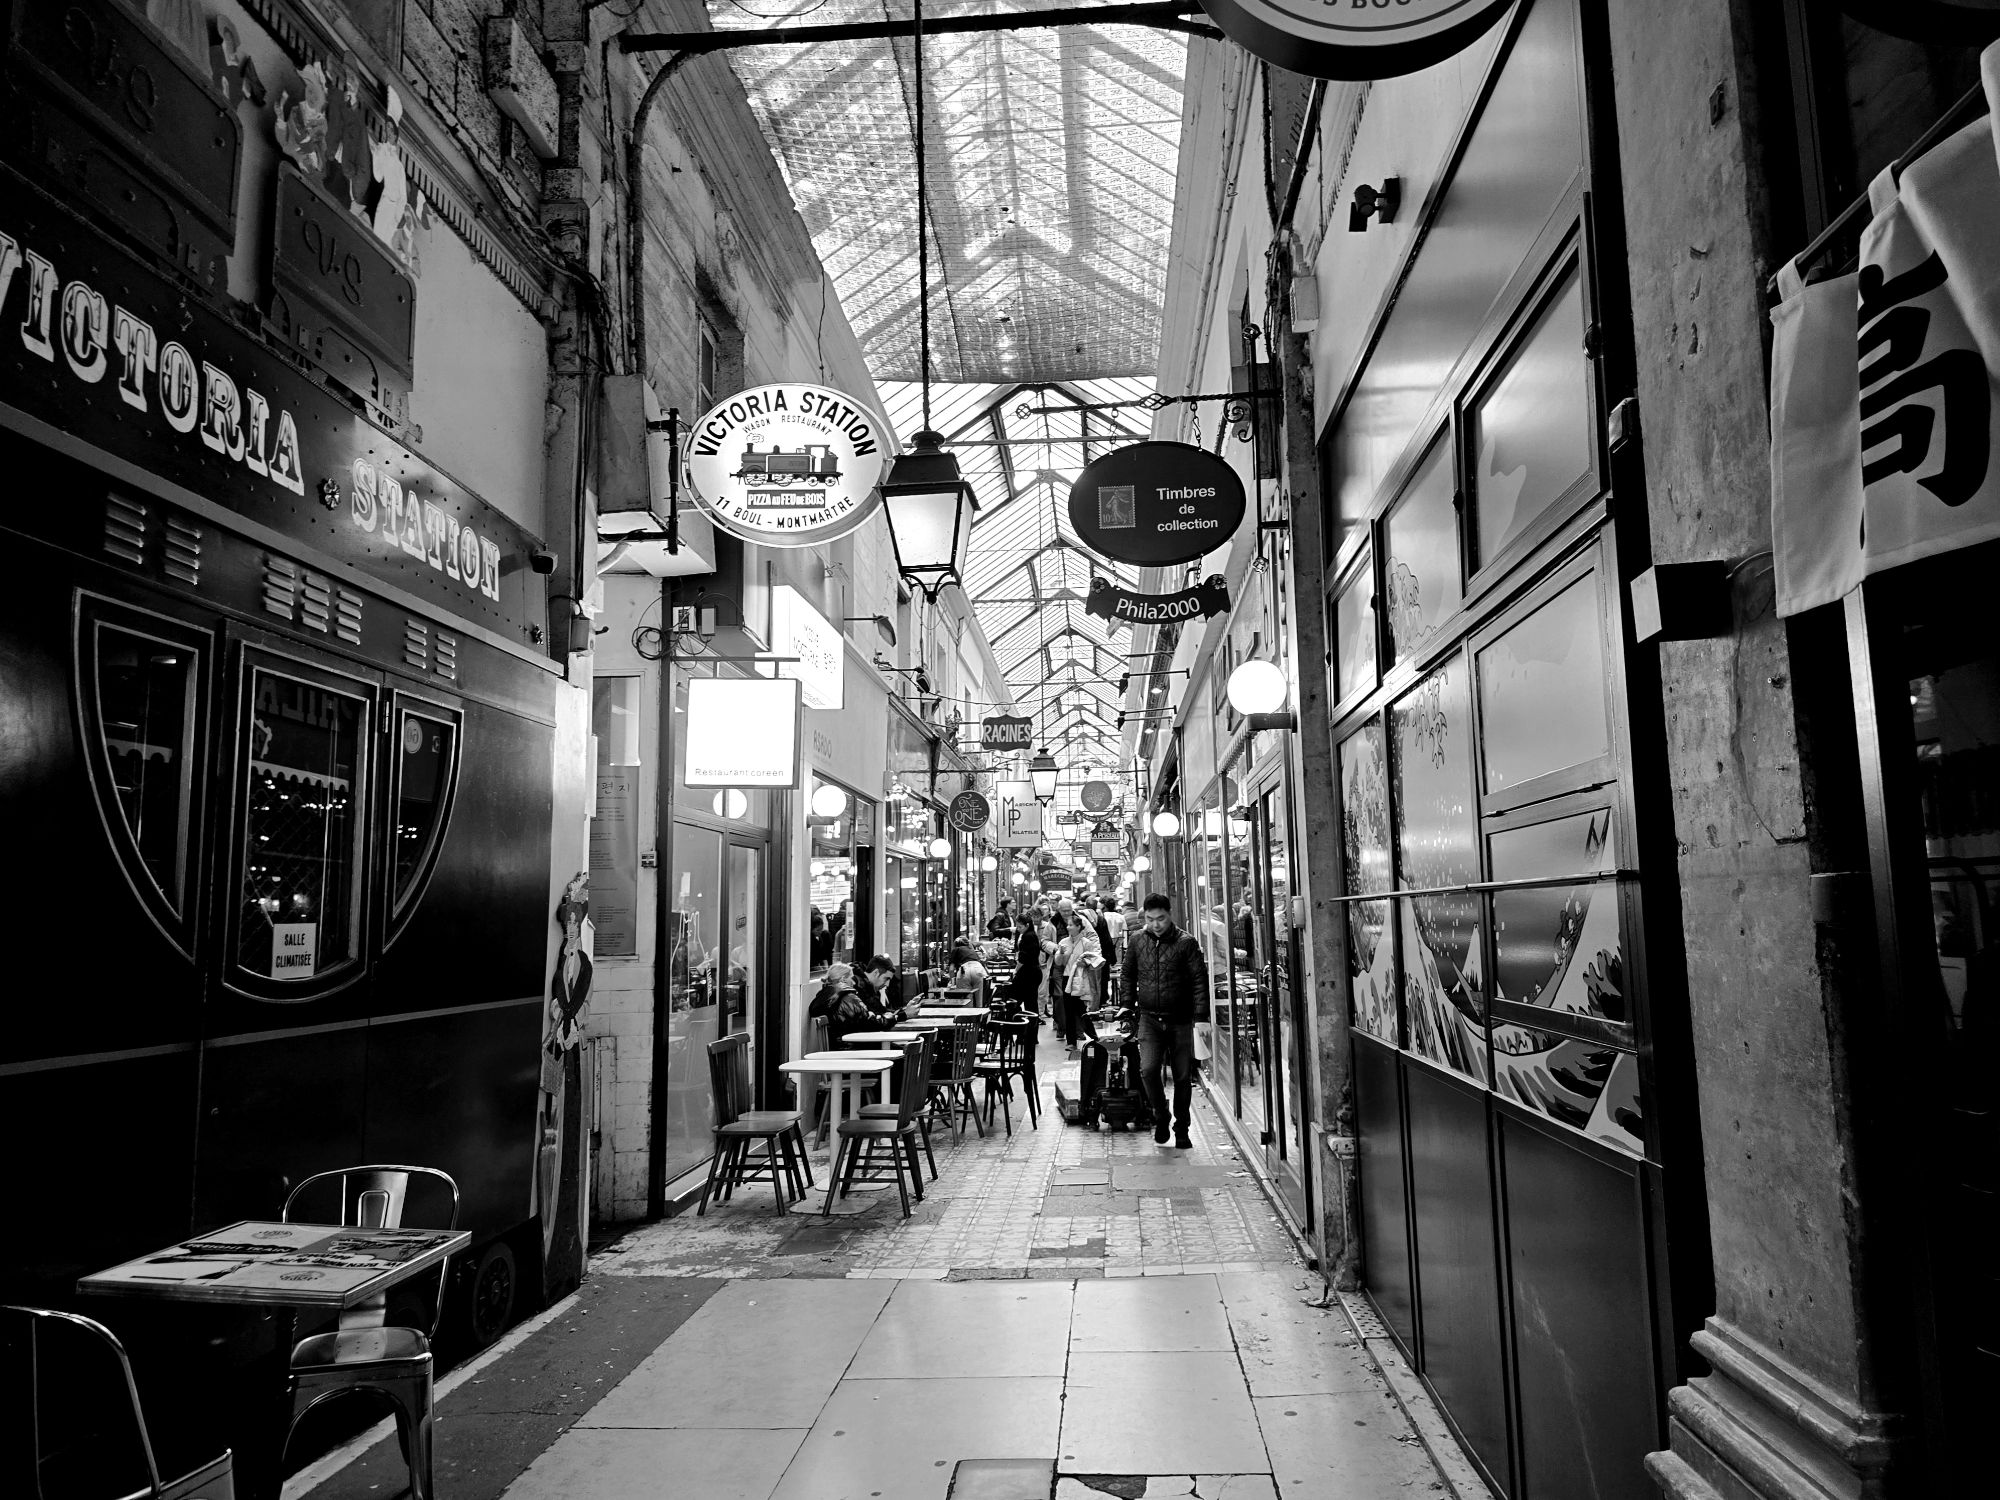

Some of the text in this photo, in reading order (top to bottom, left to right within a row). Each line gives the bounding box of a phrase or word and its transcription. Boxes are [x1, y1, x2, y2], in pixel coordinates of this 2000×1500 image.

[694, 389, 877, 457] VICTORIA STATION
[742, 414, 833, 436] WAGON RESTAURANT
[747, 493, 771, 506] PIZZA
[772, 495, 781, 506] AU
[780, 493, 796, 506] FEU
[805, 493, 825, 506] BOIS
[1156, 486, 1216, 500] Timbres
[715, 495, 730, 510] 11
[733, 506, 762, 526] BOUL
[776, 495, 854, 529] MONTMARTRE
[1178, 504, 1196, 515] de
[351, 457, 500, 602] STATION
[1157, 518, 1219, 532] collection
[1115, 597, 1200, 619] Phila2000
[983, 724, 1031, 743] RACINES
[695, 768, 748, 776] Restaurant
[284, 933, 306, 946] SALLE
[275, 950, 312, 968] CLIMATISÉE
